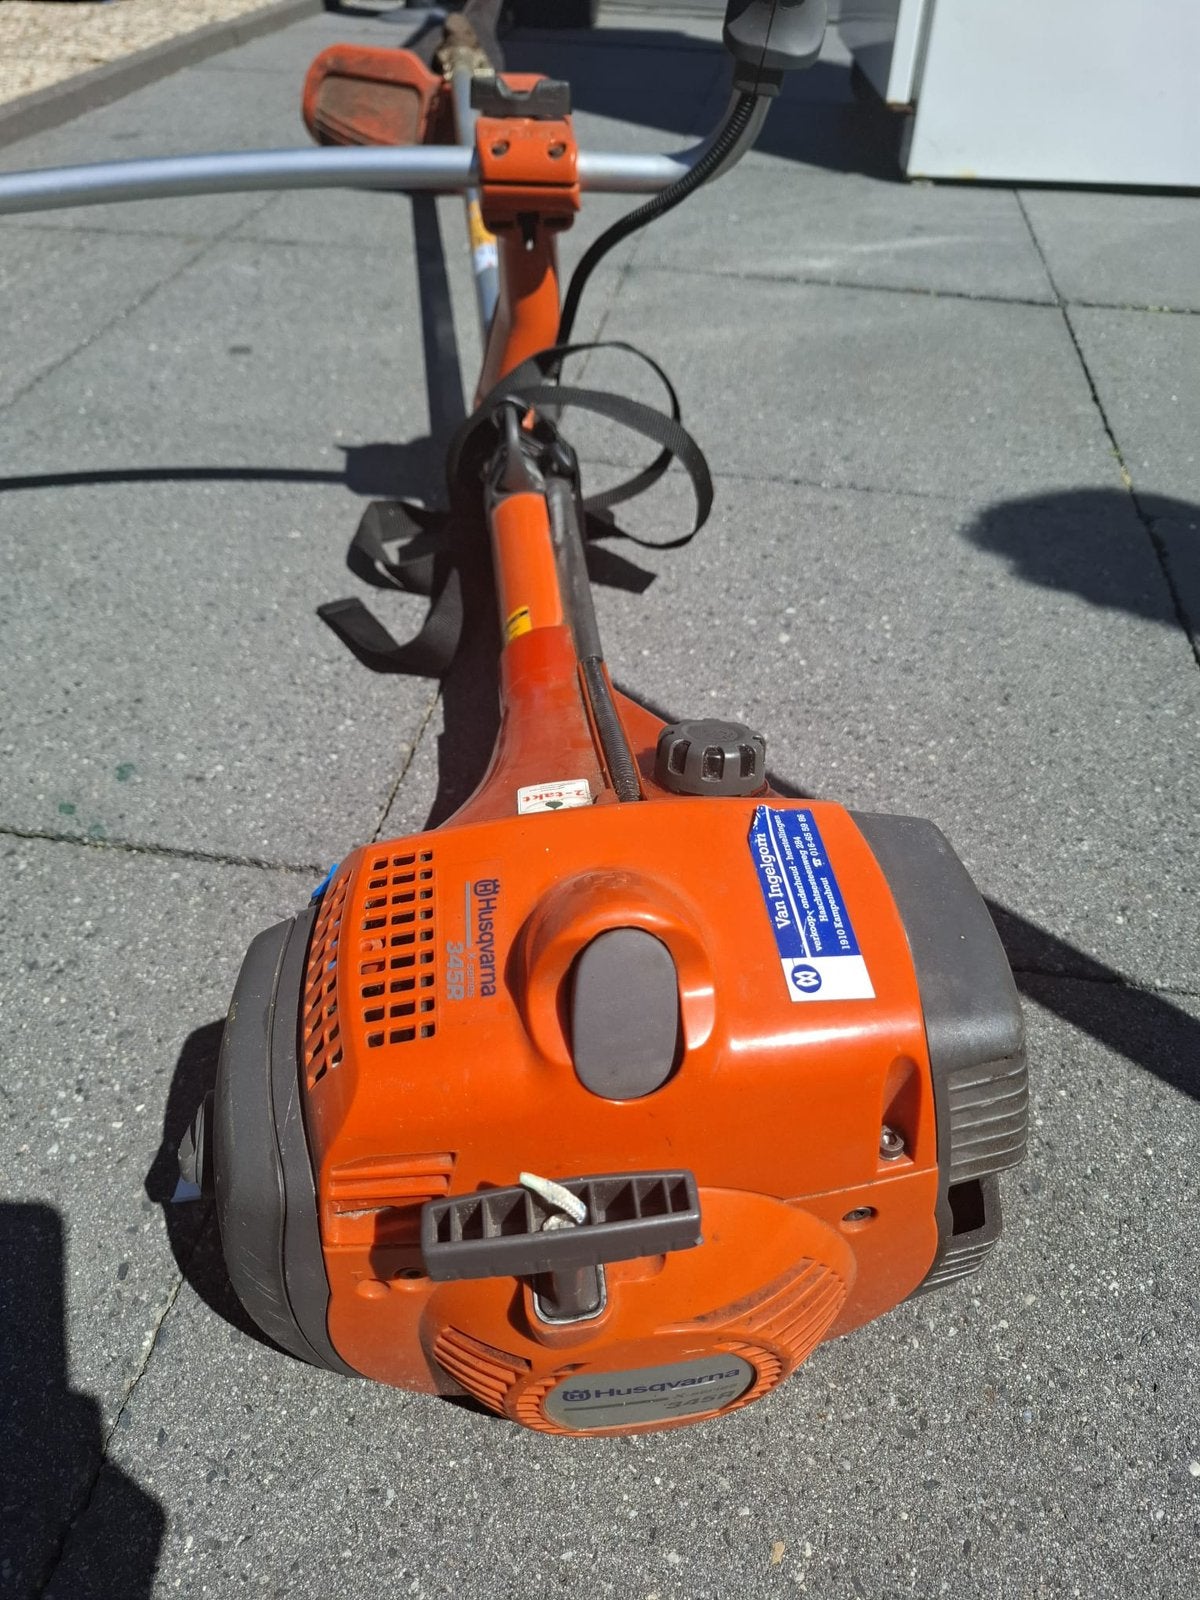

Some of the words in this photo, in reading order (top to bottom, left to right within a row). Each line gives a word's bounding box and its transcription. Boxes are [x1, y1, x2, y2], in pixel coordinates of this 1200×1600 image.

[522, 790, 584, 802] 2-takt
[774, 815, 793, 860] herstellingen
[793, 837, 806, 848] 284
[801, 823, 810, 831] 59
[755, 833, 784, 898] Ingelgom
[790, 866, 810, 908] onderhoud
[800, 850, 828, 922] Haachtsesteenweg
[820, 877, 843, 928] Kampenhout
[774, 901, 791, 928] Van
[807, 916, 822, 951] verkoop
[476, 898, 497, 997] Husqvarna
[837, 929, 850, 949] 1910
[446, 941, 464, 1000] 345R
[595, 1369, 740, 1398] Husqvarna
